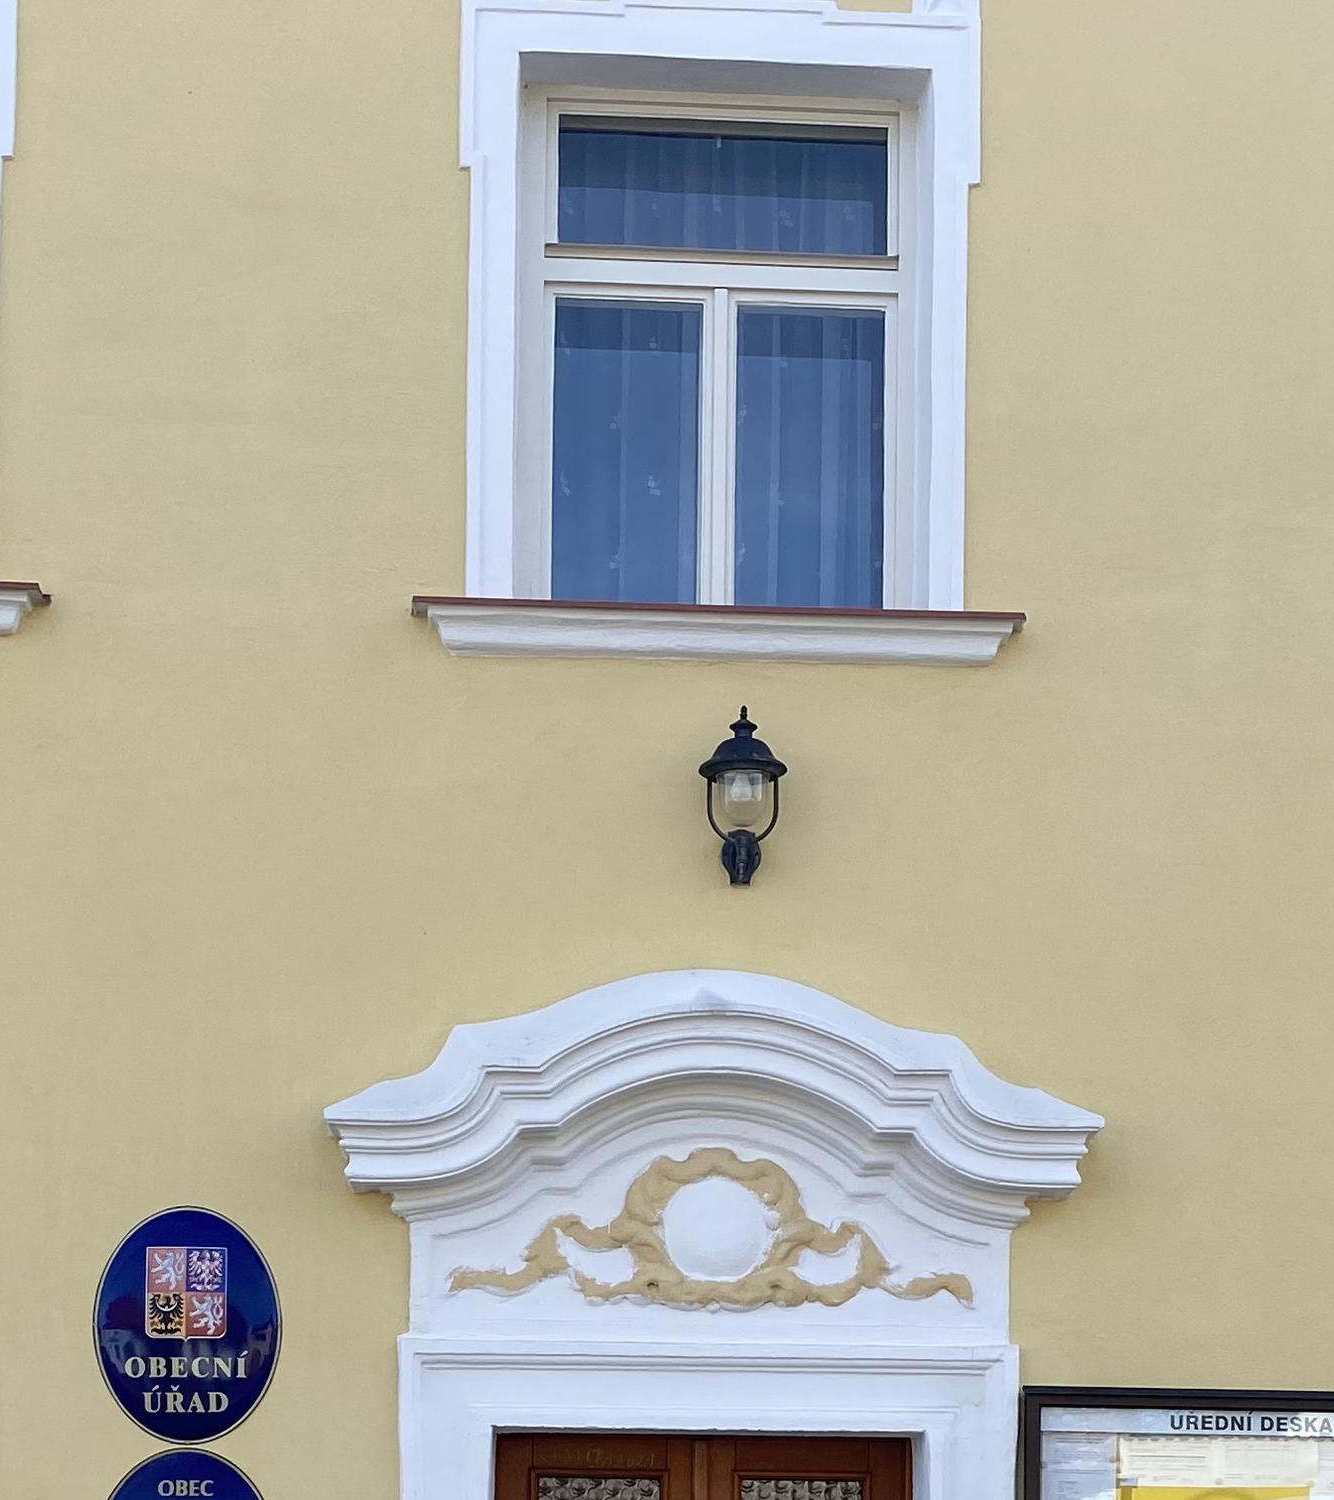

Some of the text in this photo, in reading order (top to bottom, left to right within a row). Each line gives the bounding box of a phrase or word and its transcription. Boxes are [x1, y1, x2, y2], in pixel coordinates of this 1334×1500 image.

[124, 1350, 248, 1379] OBECNÍ
[143, 1385, 229, 1413] ÚŘAD
[1260, 1416, 1333, 1433] DESKA
[157, 1479, 214, 1497] OBEC
